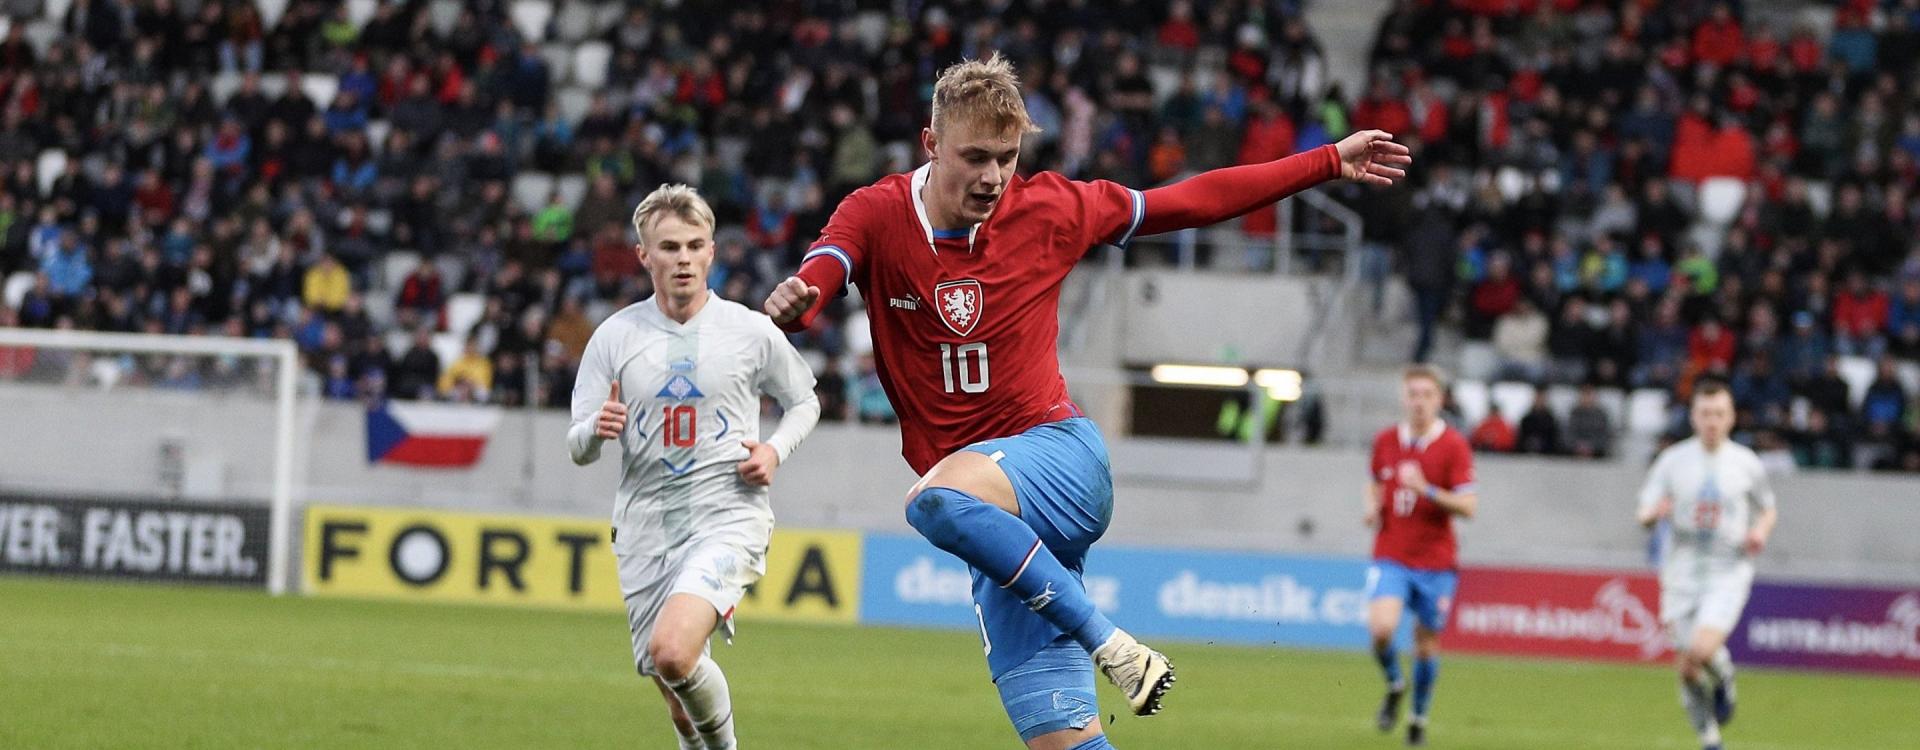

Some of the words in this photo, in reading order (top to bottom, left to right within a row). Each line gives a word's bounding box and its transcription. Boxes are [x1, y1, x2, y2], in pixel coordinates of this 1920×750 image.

[940, 342, 990, 393] 10
[663, 405, 696, 448] 10
[83, 508, 257, 577] FASTER.
[317, 520, 843, 609] FORTA
